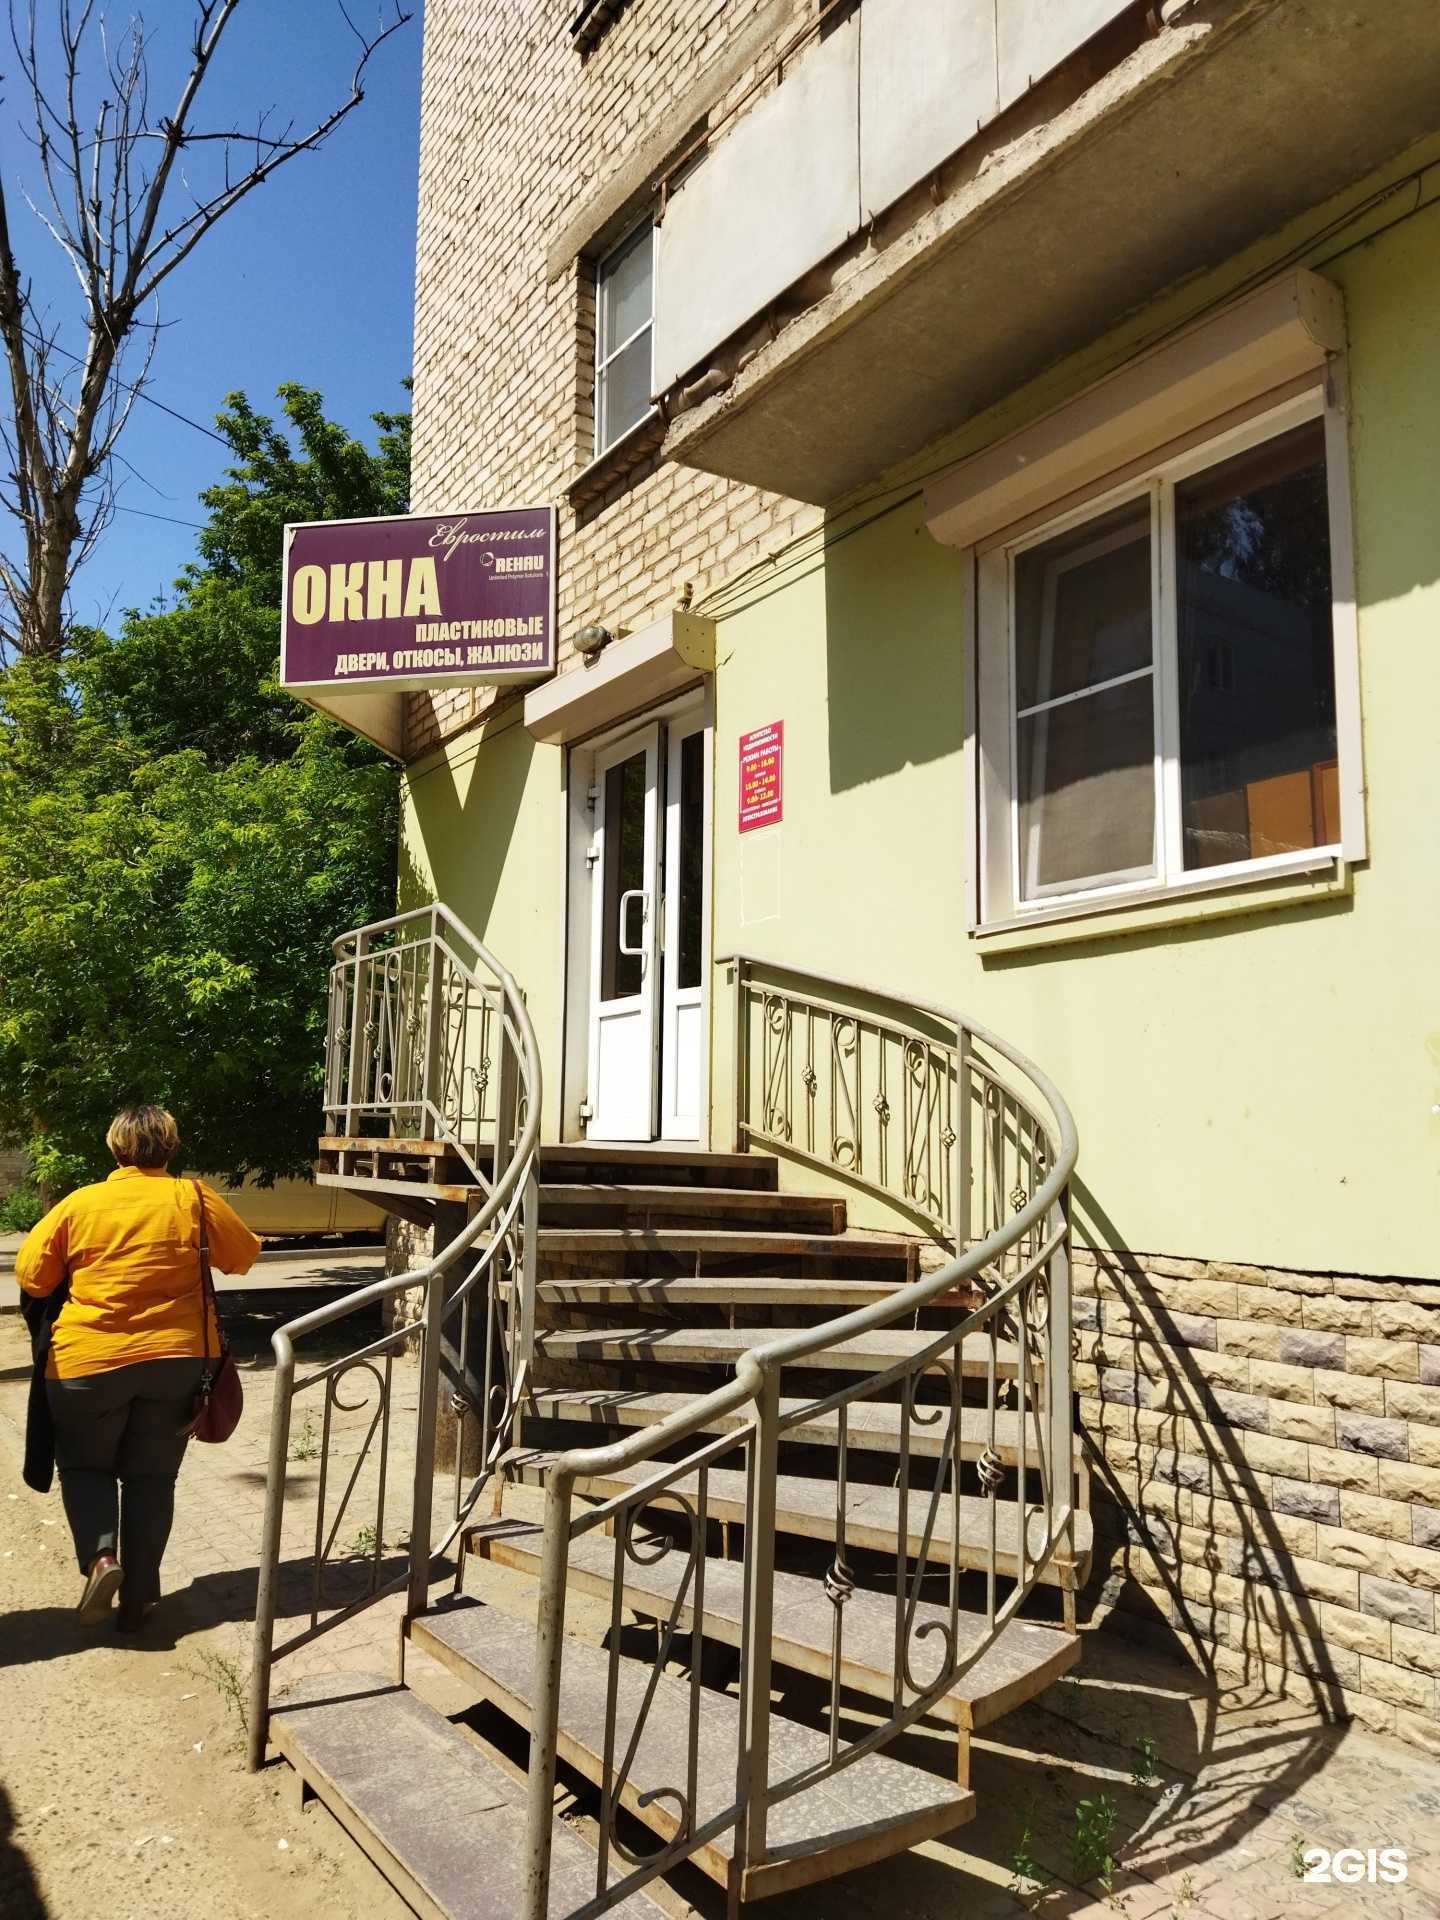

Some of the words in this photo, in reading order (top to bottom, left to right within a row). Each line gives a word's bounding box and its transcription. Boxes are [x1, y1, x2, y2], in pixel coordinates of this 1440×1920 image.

[429, 517, 545, 561] Евростиль
[495, 555, 544, 573] REHAU
[292, 556, 443, 625] ОКНА
[415, 616, 544, 643] ПЛАСТИКОВЫЕ
[334, 651, 390, 676] ДВЕРИ,
[392, 647, 465, 669] ОТКОСЫ,
[466, 642, 544, 666] ЖАЛЮЗИ
